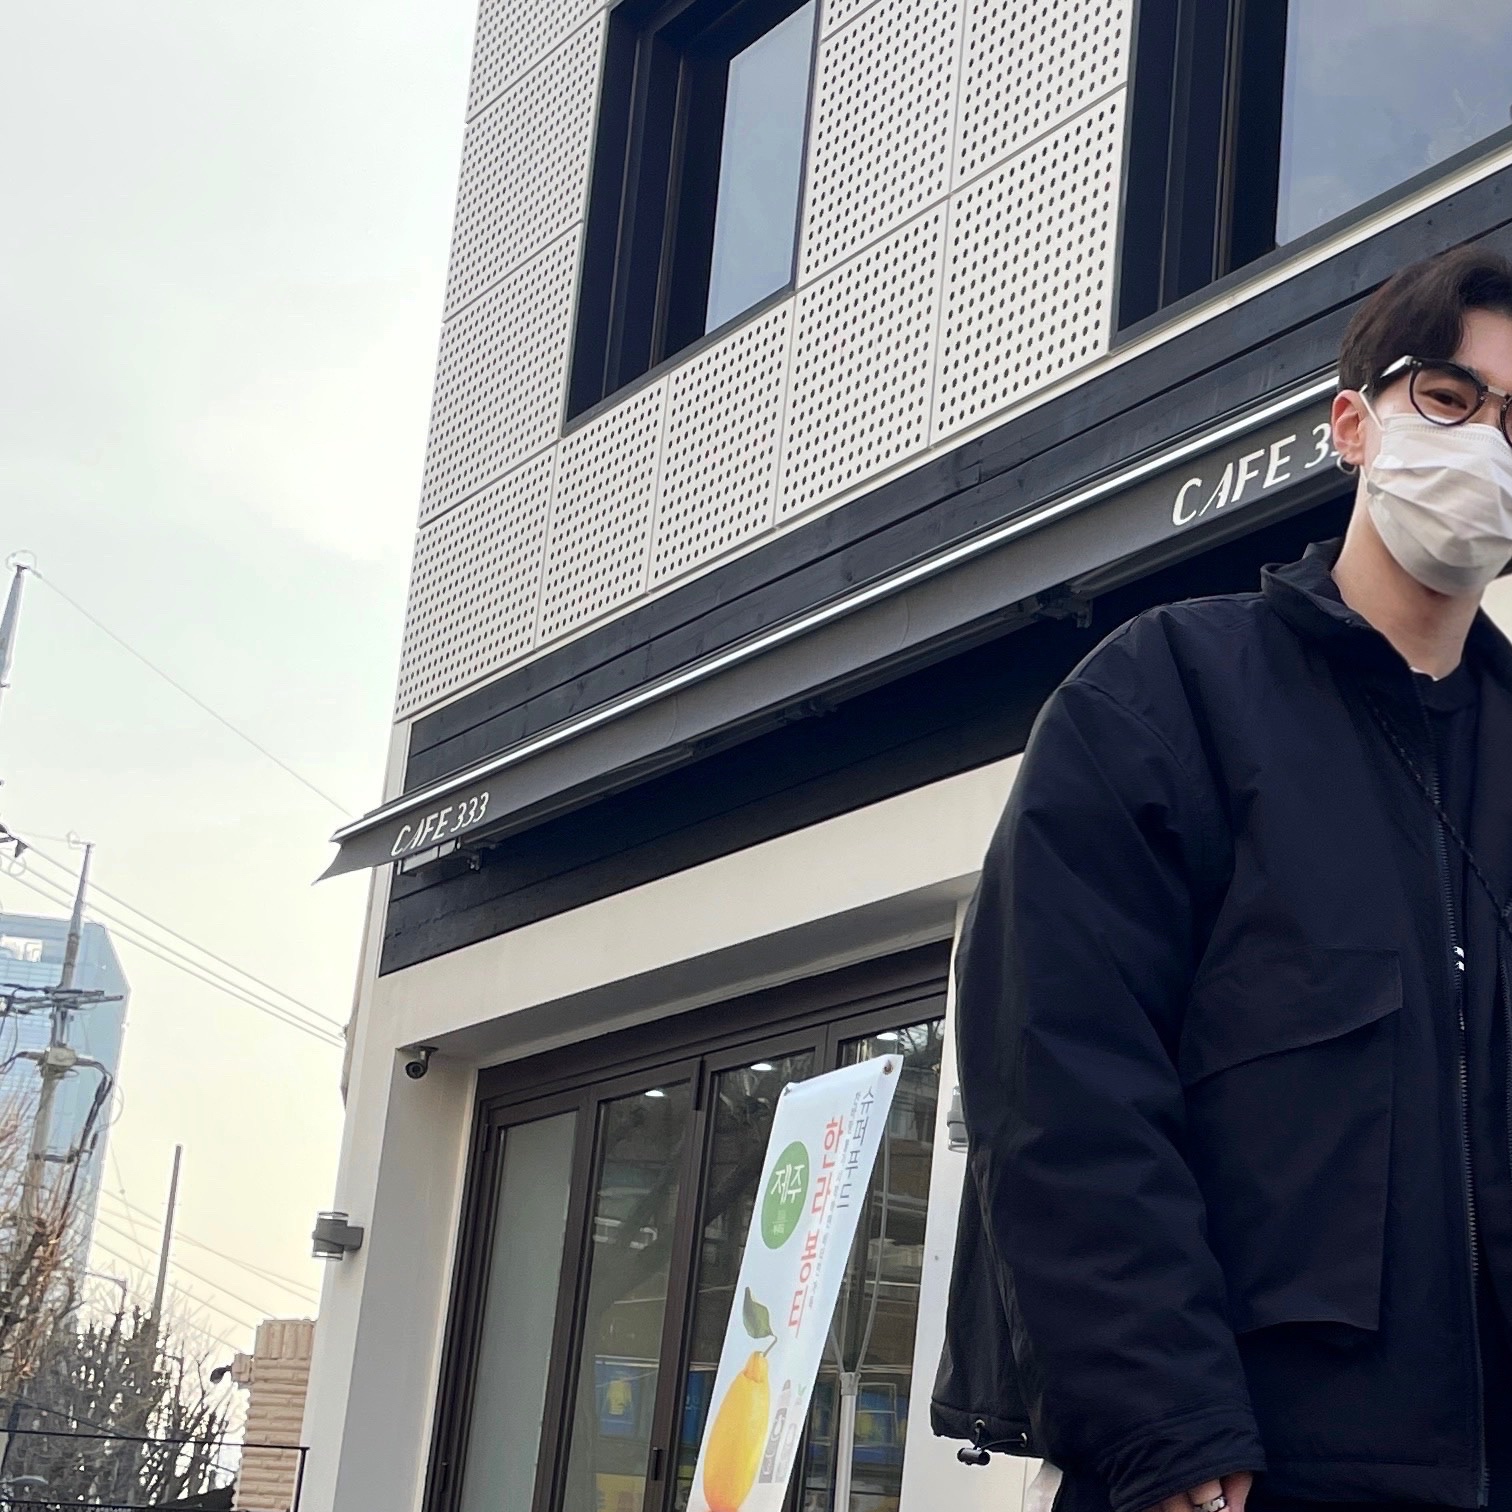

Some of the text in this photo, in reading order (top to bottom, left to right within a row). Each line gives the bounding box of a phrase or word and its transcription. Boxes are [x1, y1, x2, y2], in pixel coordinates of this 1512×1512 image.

[1172, 423, 1341, 526] CAFE 3
[391, 791, 490, 857] CAFE 333
[770, 1163, 806, 1205] 제주
[836, 1086, 874, 1209] 슈퍼푸드
[788, 1115, 844, 1338] 한라봉티
